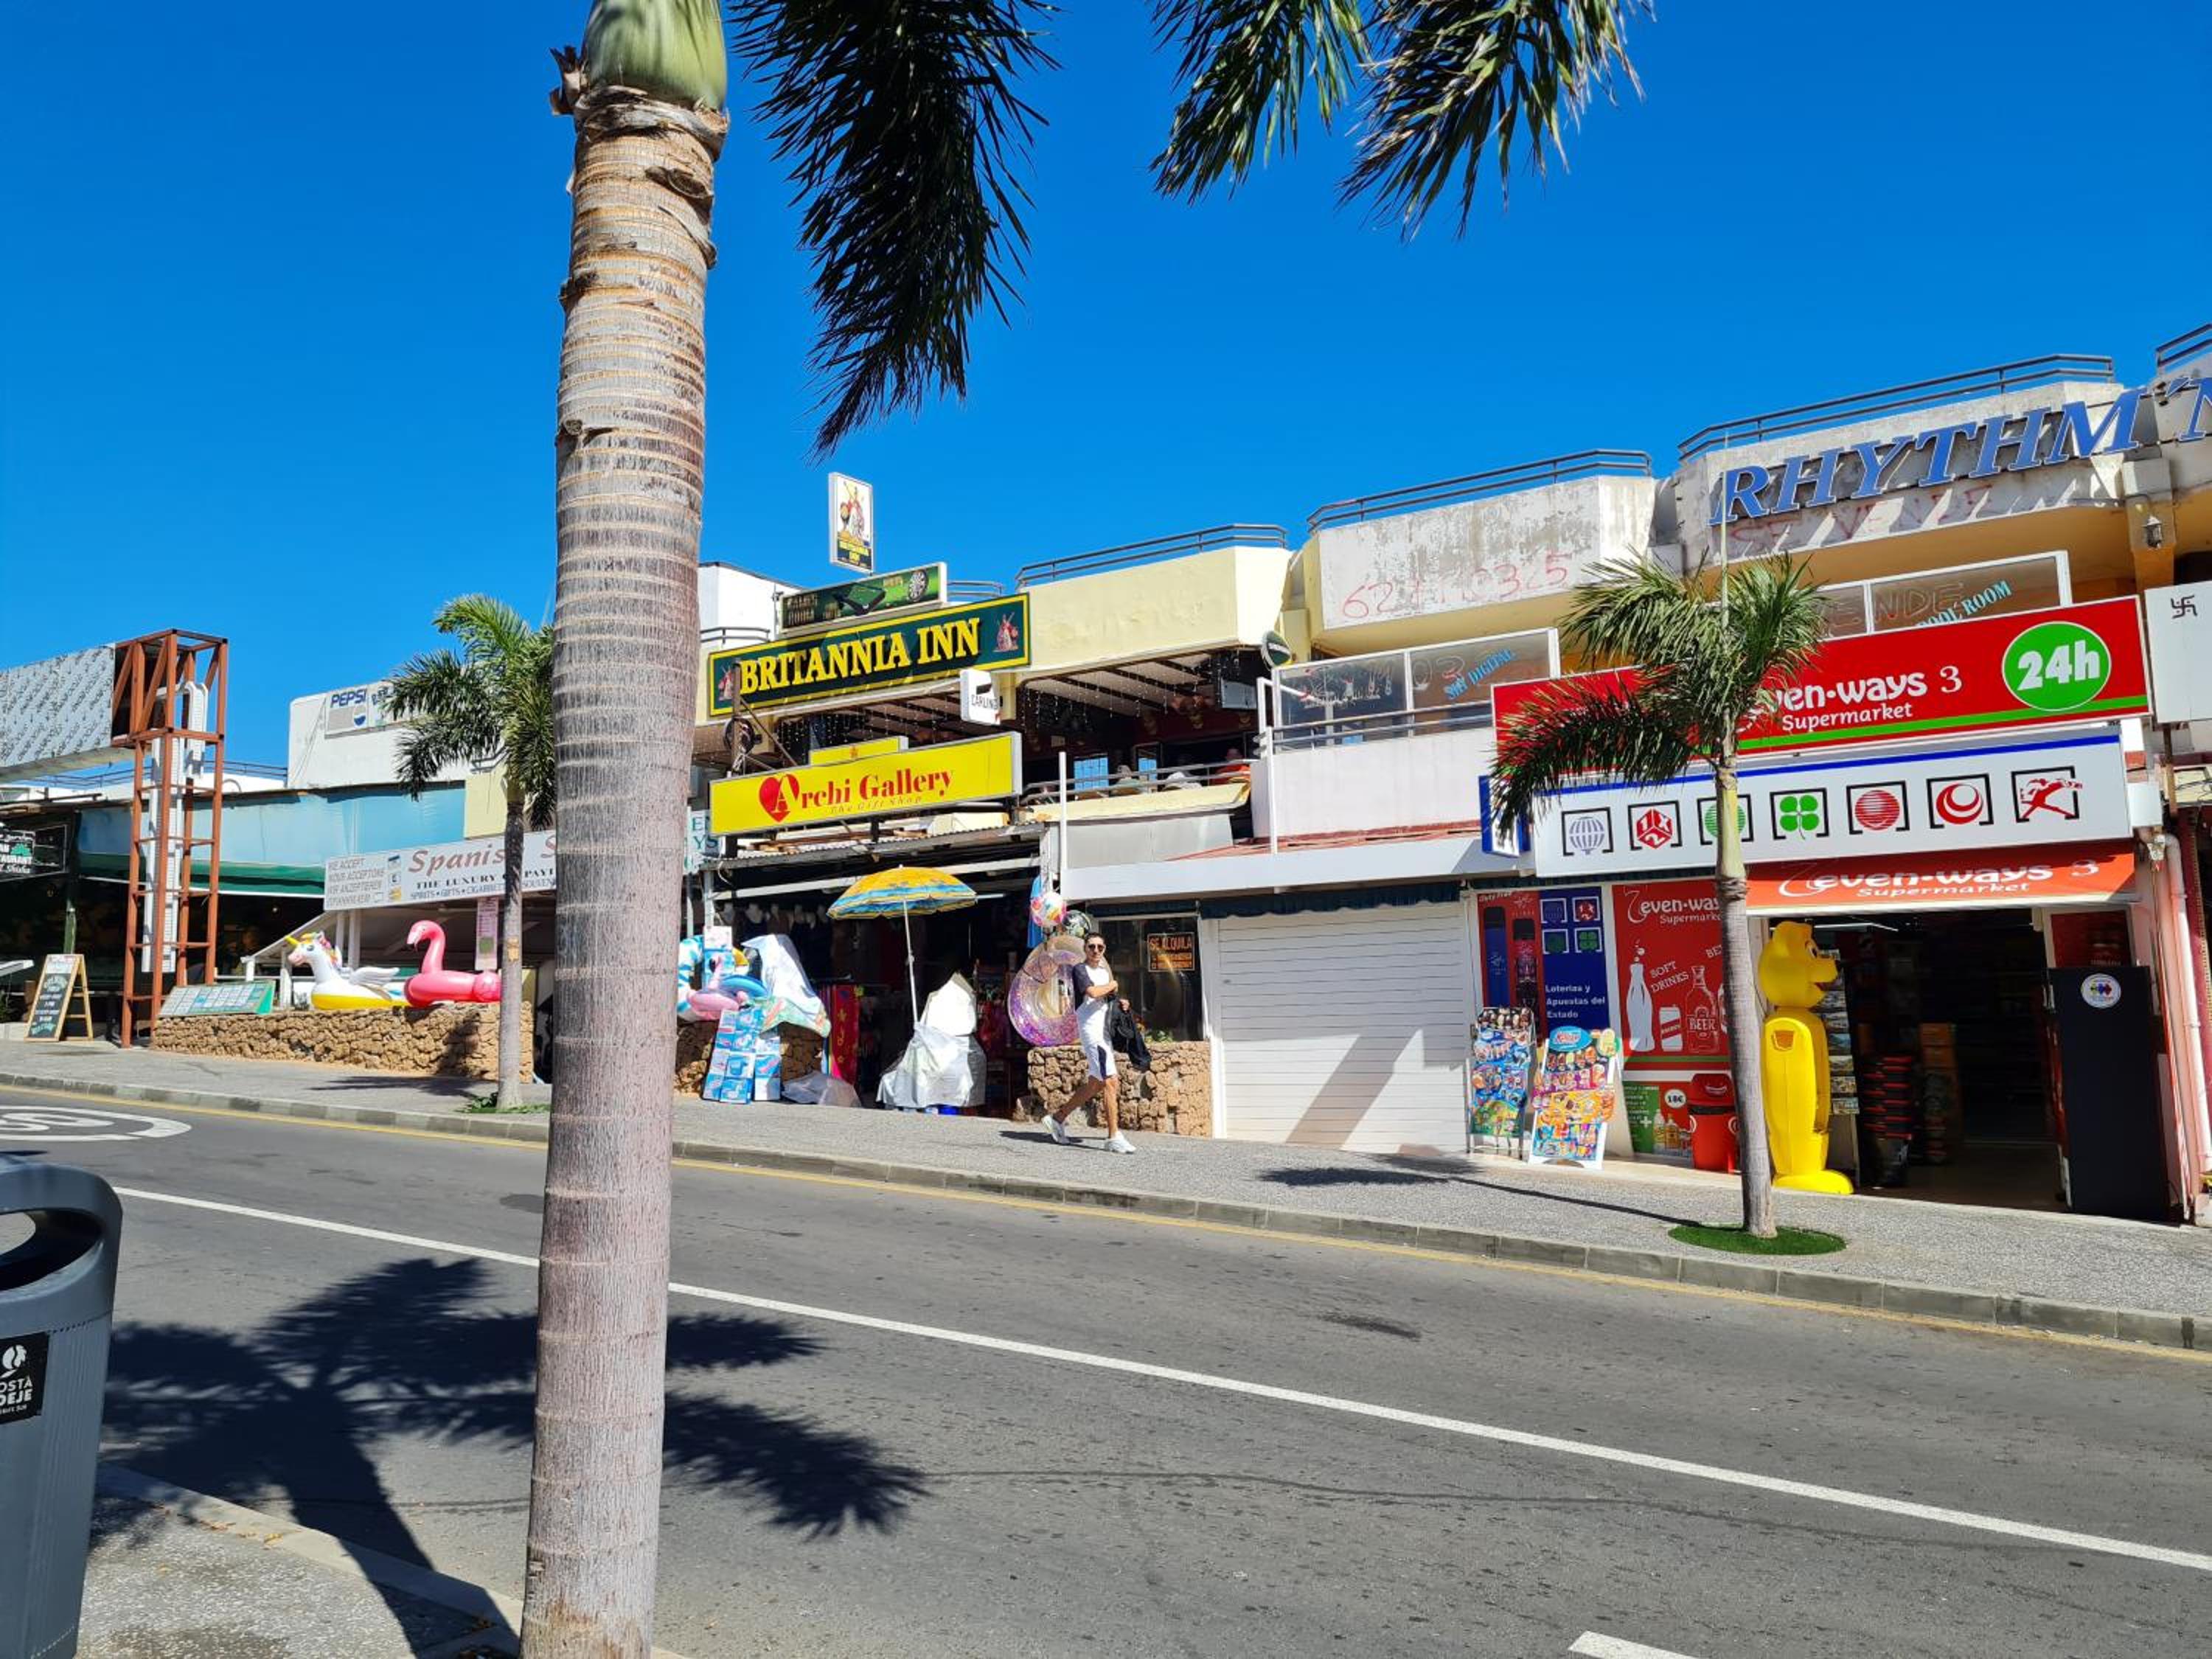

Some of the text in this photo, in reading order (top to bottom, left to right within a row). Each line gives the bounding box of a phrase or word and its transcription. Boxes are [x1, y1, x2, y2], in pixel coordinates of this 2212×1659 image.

[1709, 387, 2146, 526] RHYTHM
[1917, 580, 2013, 627] OOL ROOM
[740, 617, 981, 695] BRITANNIA INN
[2017, 639, 2101, 691] 24h
[1939, 665, 1963, 693] 3
[330, 687, 368, 708] PEPSI
[1781, 701, 1913, 734] Supermarket
[767, 768, 953, 817] Archi Gallery
[408, 843, 507, 877] Spanis
[2070, 859, 2100, 877] 3
[417, 878, 439, 889] THE
[446, 874, 497, 886] LUXURY
[1856, 882, 2029, 898] Supermarket
[1650, 961, 1677, 978] SOFT
[1585, 985, 1591, 994] y
[1650, 971, 1689, 993] DRINKS
[1546, 995, 1606, 1007] Apuestas del
[1546, 1010, 1579, 1019] Estado
[1688, 1017, 1716, 1032] BEER
[0, 1376, 33, 1394] OSTA
[0, 1388, 33, 1407] DEJE
